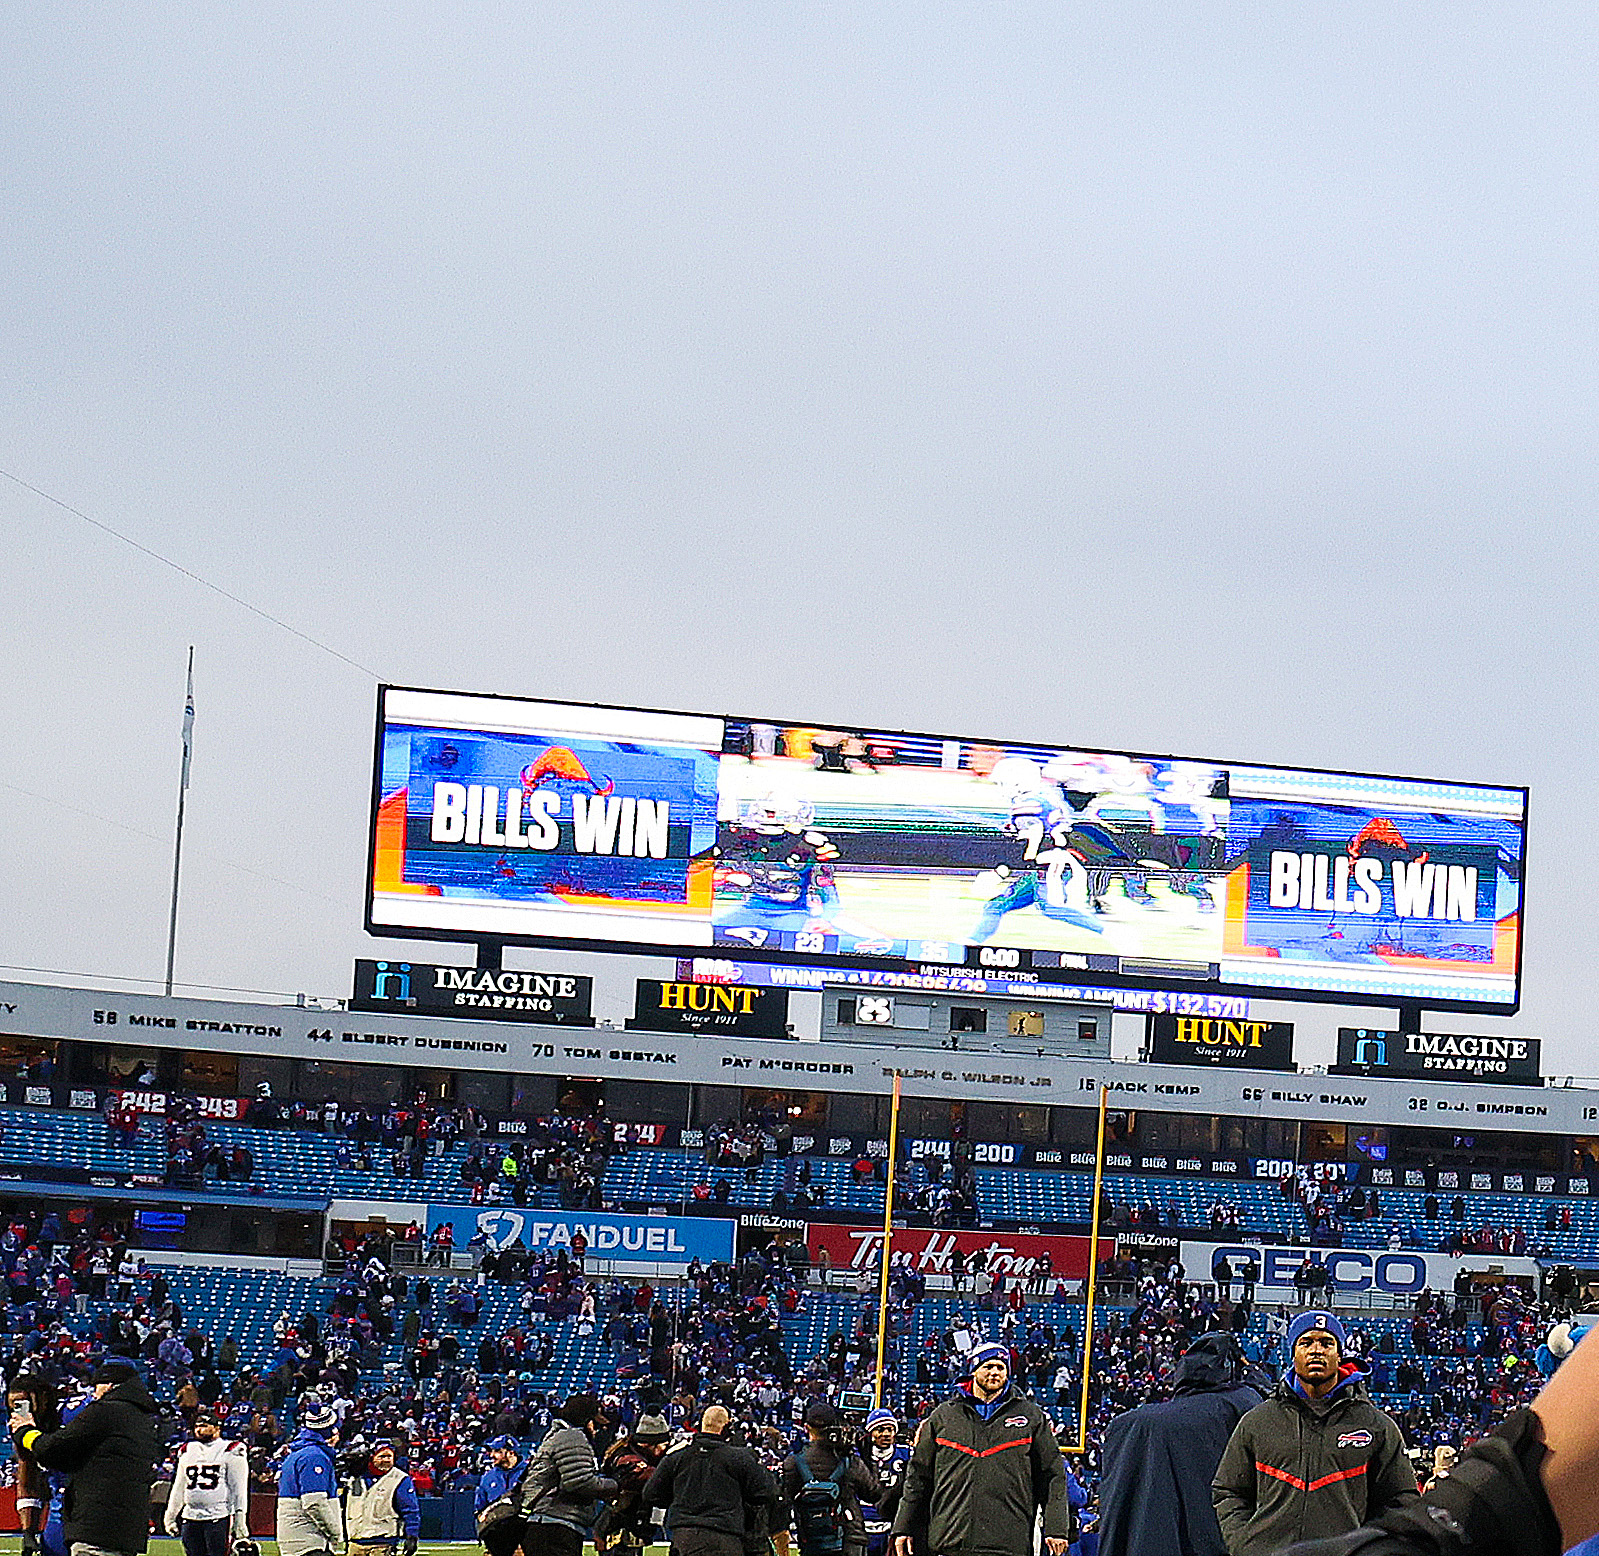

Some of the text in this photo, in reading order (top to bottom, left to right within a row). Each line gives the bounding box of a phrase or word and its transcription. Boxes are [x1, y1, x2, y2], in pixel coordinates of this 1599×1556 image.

[431, 783, 669, 858] BILLS WIN
[1270, 851, 1477, 922] BILLS WIN
[434, 967, 577, 998] IMAGINE
[919, 965, 983, 981] MITSUBISHI
[984, 970, 1040, 983] ELECTRIC
[455, 992, 553, 1012] STAFFING
[659, 982, 760, 1013] HUNT
[130, 1015, 176, 1028] MIKE
[186, 1021, 281, 1036] STRATTON
[680, 1013, 738, 1025] Since 1911
[307, 1029, 507, 1053] 44 ELBERT DUBENION
[1175, 1017, 1267, 1048] HUNT
[532, 1043, 676, 1063] 70 TOM SESTAK
[1194, 1046, 1247, 1059] Since 1911
[1405, 1033, 1528, 1060] IMAGINE
[722, 1058, 752, 1068] PAT
[1423, 1057, 1507, 1074] STAFFING
[962, 1073, 1024, 1085] WILSON
[1079, 1078, 1199, 1095] 15 JACK KEMP
[1242, 1088, 1367, 1105] 66 BILLY SHAW
[1408, 1099, 1427, 1111] 32
[1477, 1104, 1547, 1115] SIMPSON
[1581, 1107, 1597, 1120] 12
[975, 1144, 1014, 1163] 200
[531, 1222, 685, 1252] FANDUEL
[1314, 1316, 1326, 1328] 3
